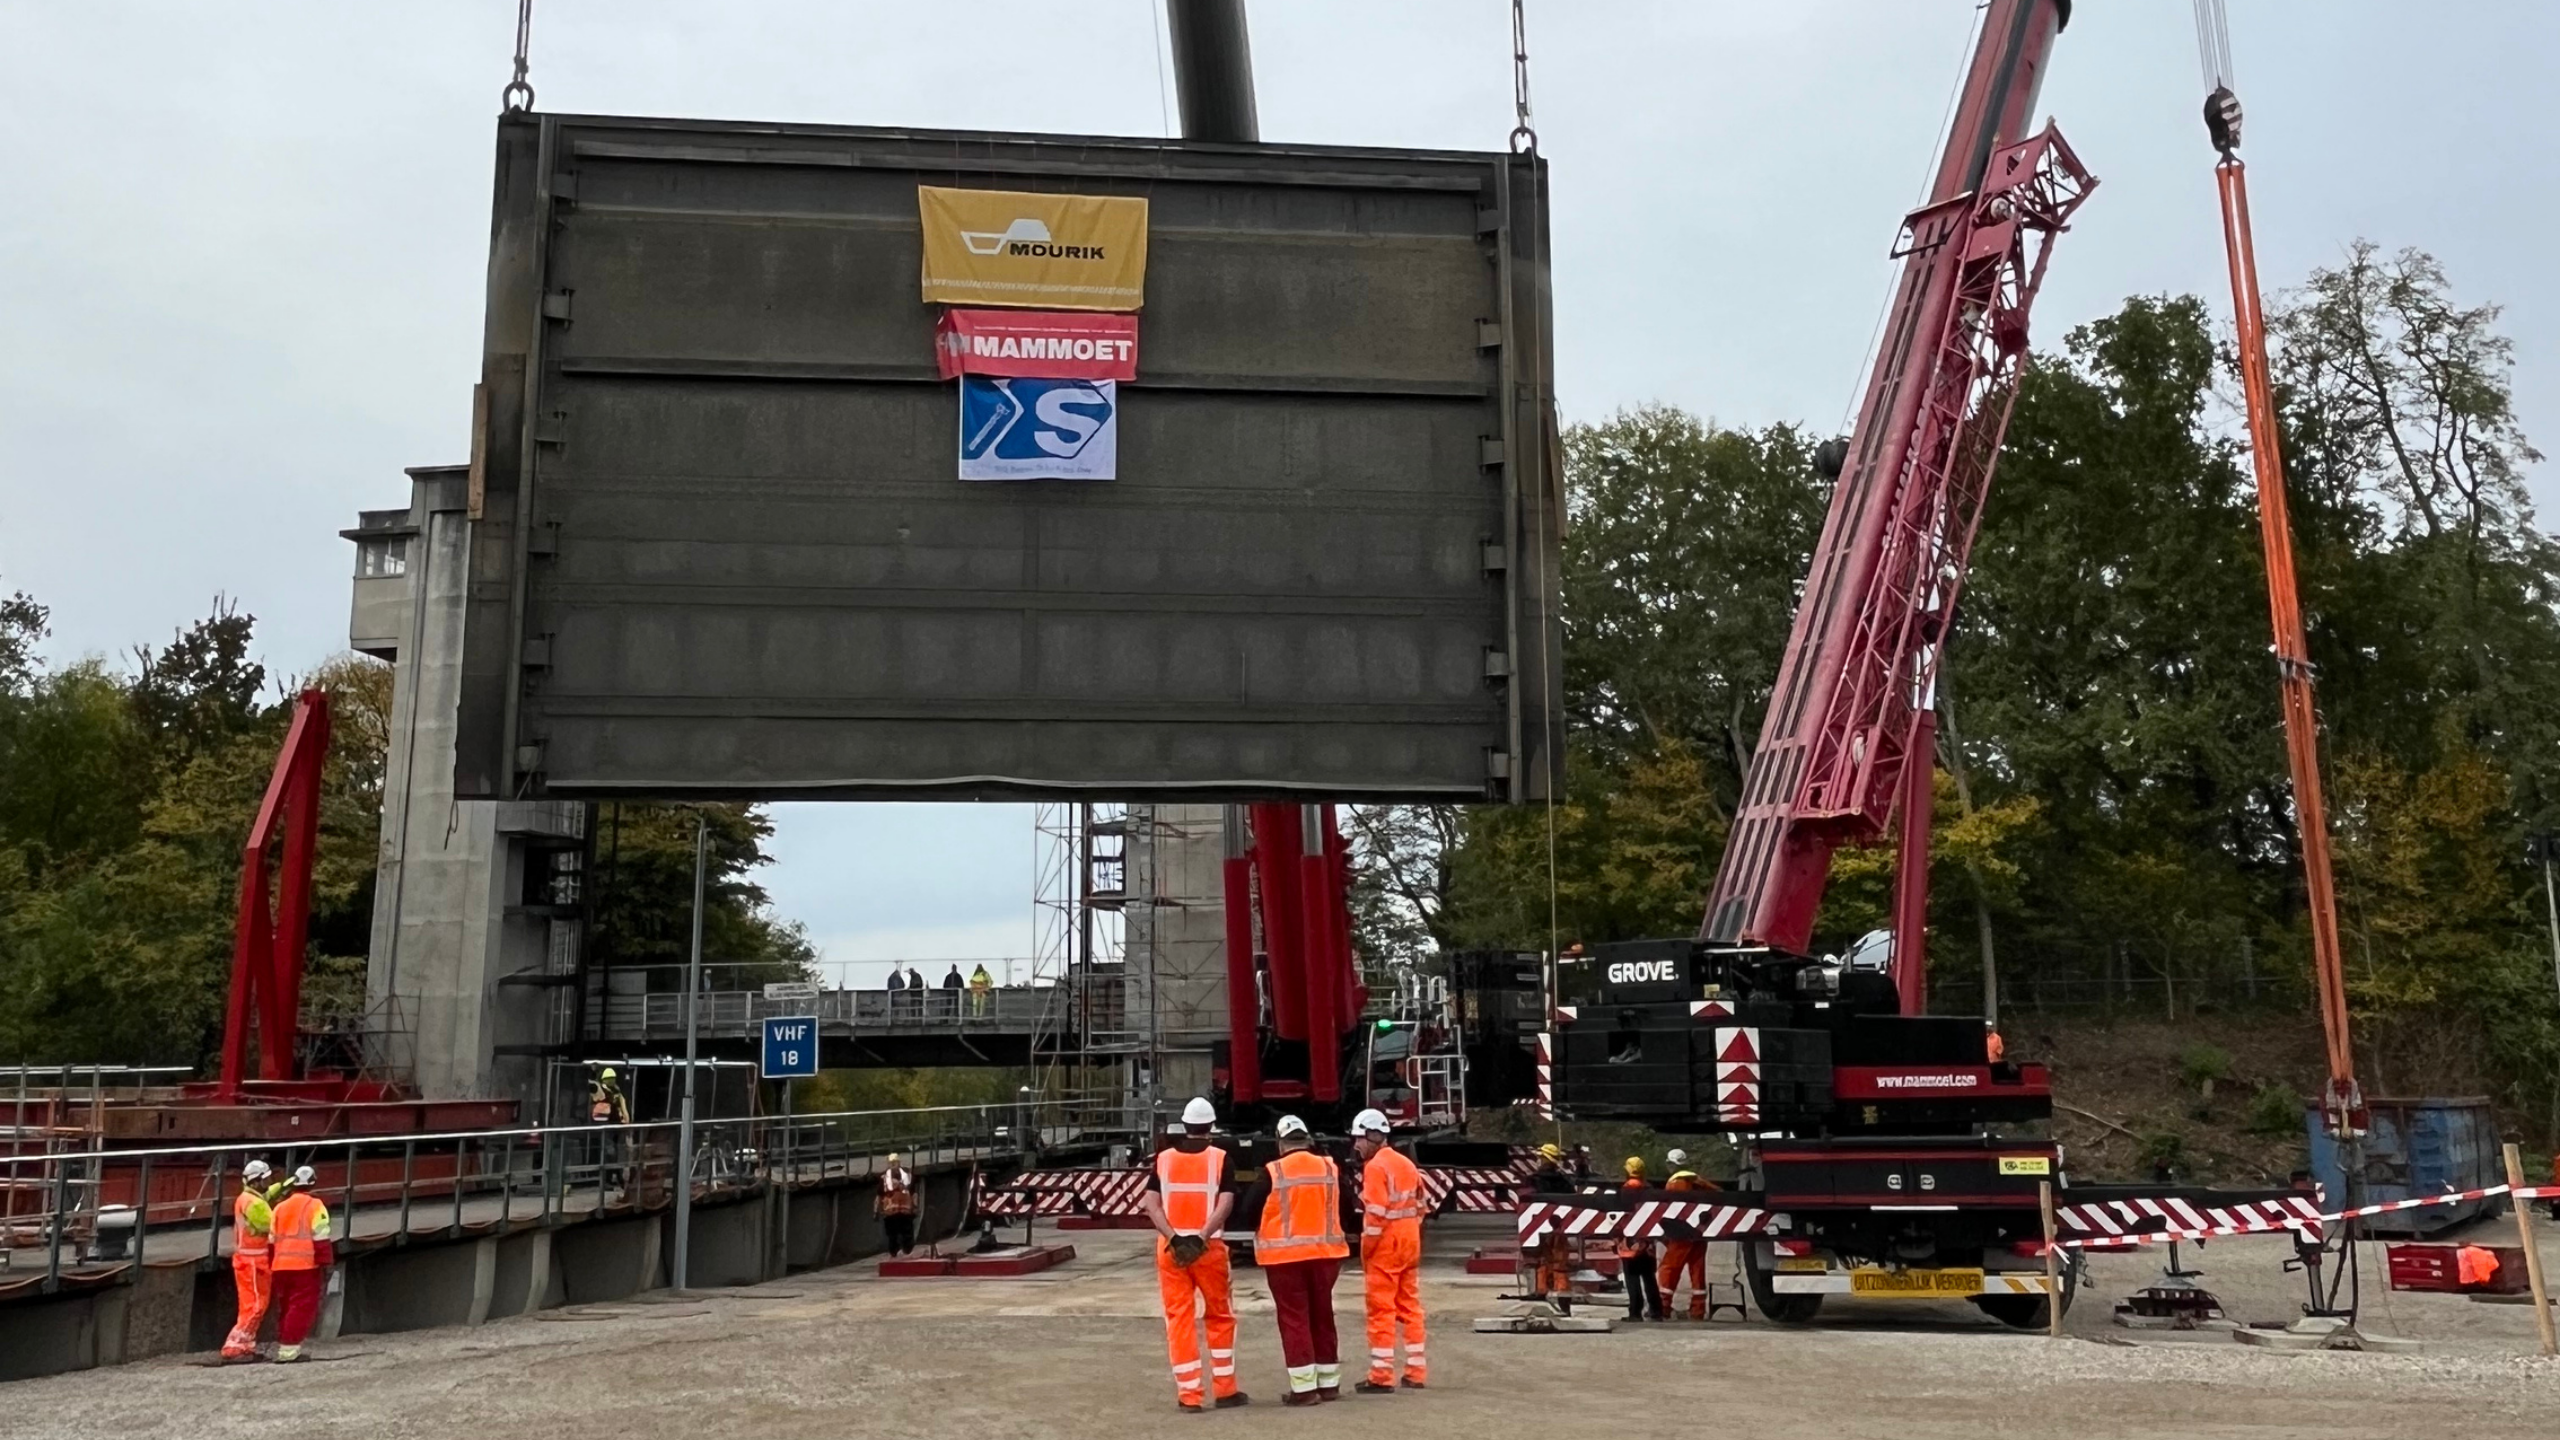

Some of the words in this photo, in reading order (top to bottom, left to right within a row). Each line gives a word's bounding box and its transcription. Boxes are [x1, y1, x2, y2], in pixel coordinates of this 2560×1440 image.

[1009, 243, 1105, 260] MOURIK
[973, 335, 1133, 362] MAMMOET
[1608, 960, 1675, 983] GROVE
[773, 1025, 808, 1042] VHF
[781, 1050, 798, 1066] 18
